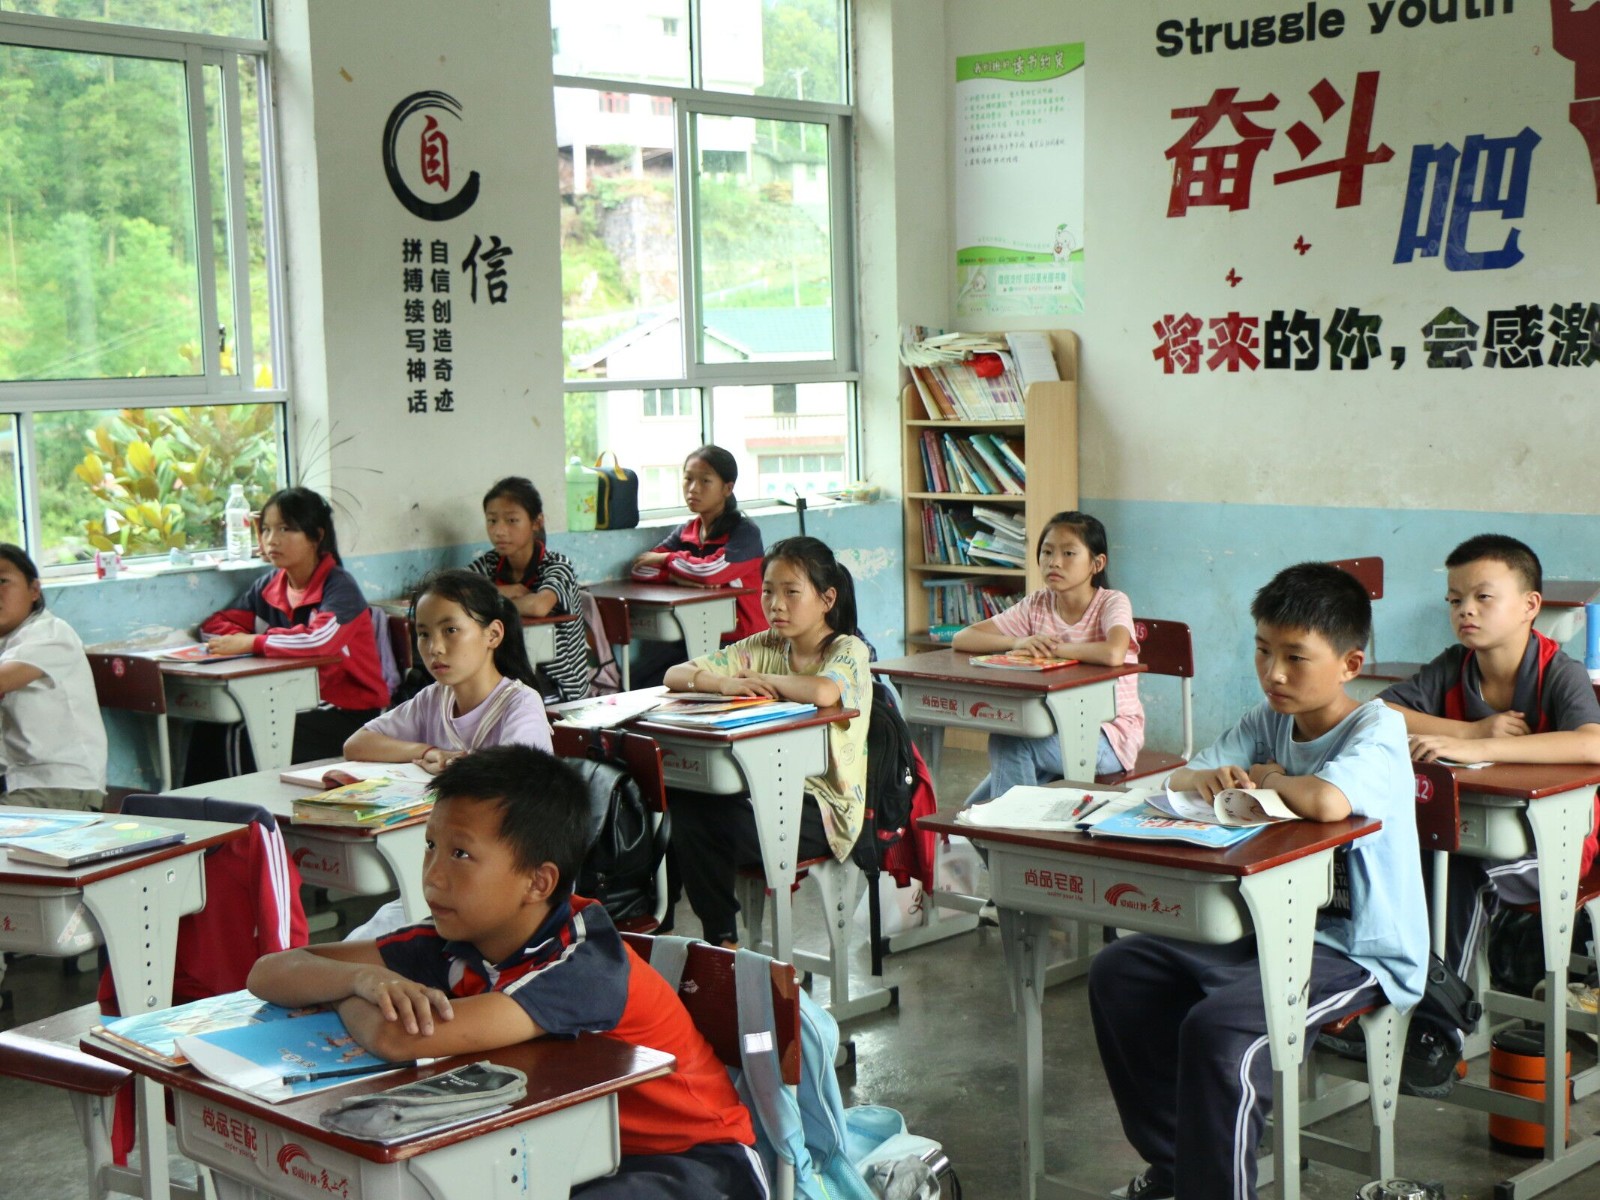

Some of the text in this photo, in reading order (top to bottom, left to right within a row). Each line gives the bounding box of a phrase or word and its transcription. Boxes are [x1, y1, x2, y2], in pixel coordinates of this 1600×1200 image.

[1156, 1, 1345, 57] Struggle
[420, 114, 450, 192] 自
[462, 234, 514, 305] 信
[401, 238, 428, 415] 拼搏续写神话
[429, 239, 455, 413] 自信创造奇迹
[1025, 869, 1084, 894] 尚品宅配
[202, 1107, 257, 1150] 尚品宅配
